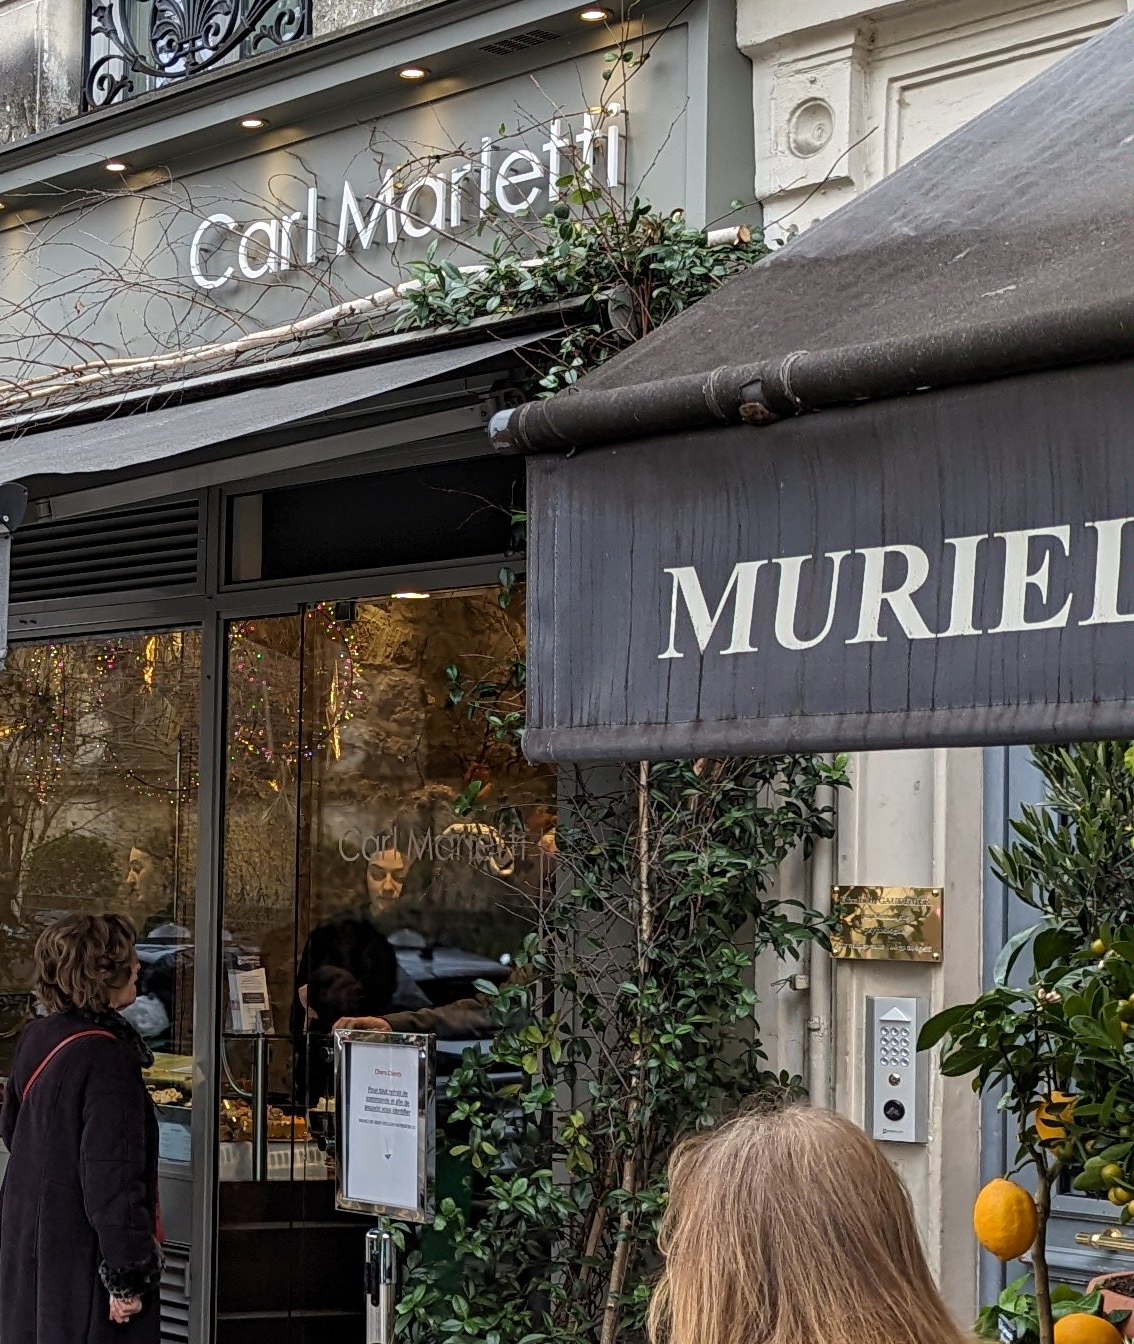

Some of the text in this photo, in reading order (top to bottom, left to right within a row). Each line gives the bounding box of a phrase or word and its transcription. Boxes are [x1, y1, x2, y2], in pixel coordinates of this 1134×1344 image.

[190, 102, 621, 289] Carl Marletti
[339, 826, 398, 862] Carl
